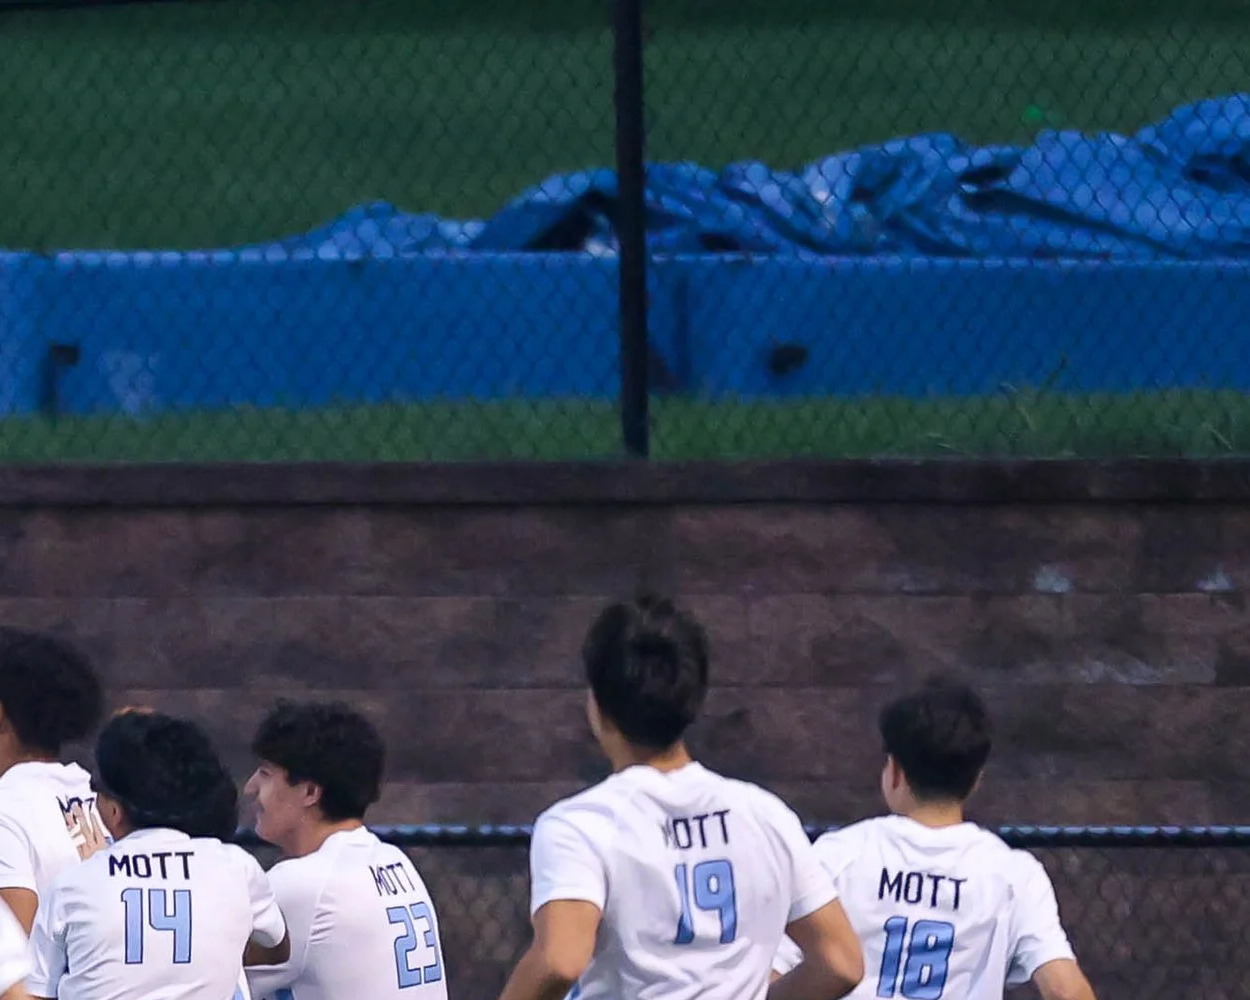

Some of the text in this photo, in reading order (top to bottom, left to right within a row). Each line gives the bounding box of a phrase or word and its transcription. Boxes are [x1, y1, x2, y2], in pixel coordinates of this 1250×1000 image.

[109, 851, 194, 879] MOTT
[369, 862, 415, 896] MOTT
[673, 859, 737, 944] 19
[878, 866, 968, 911] MOTT
[120, 887, 192, 964] 14
[385, 901, 442, 989] 23
[876, 915, 955, 1000] 18
